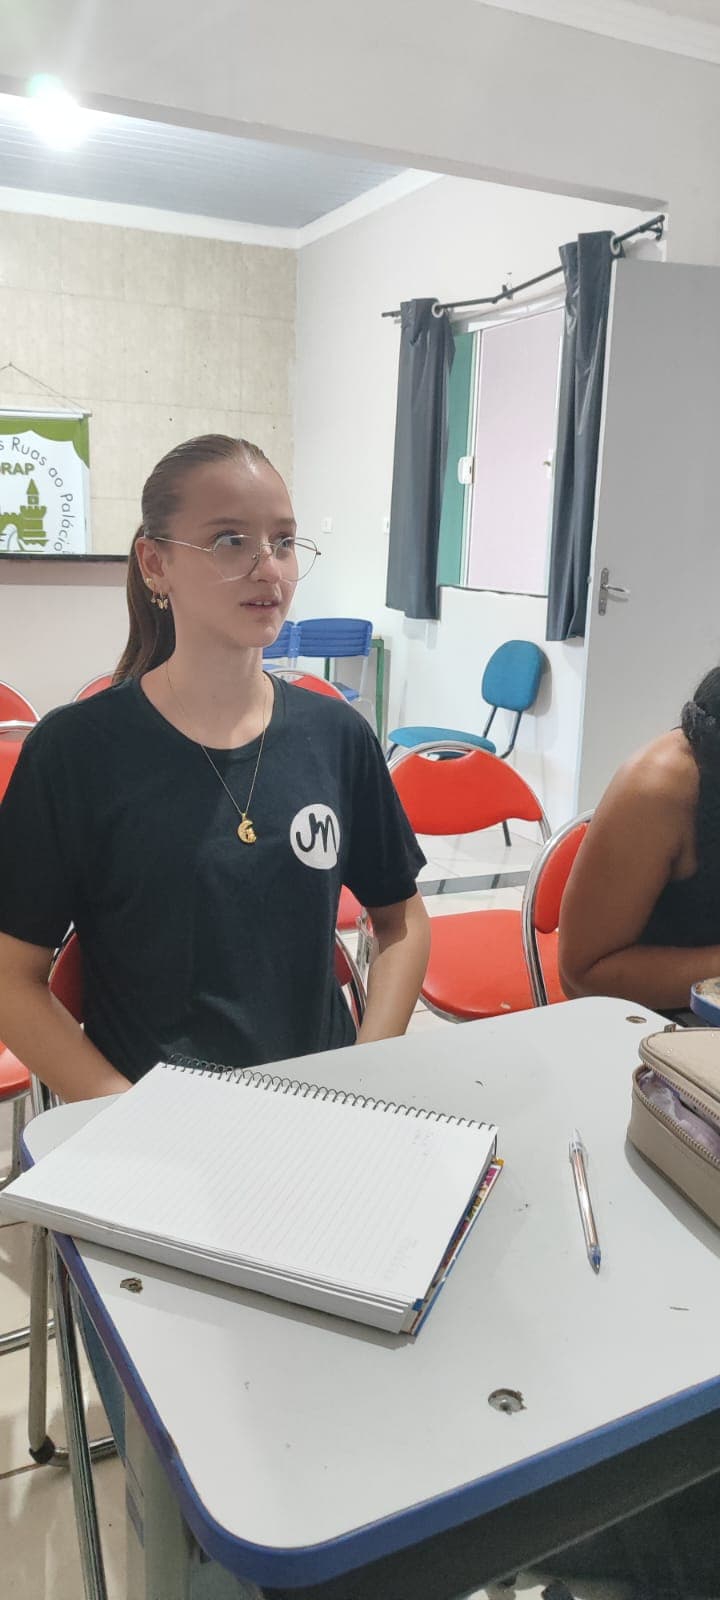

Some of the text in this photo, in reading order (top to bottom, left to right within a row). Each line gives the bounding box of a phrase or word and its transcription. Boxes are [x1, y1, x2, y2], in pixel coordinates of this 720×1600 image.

[11, 436, 48, 466] Ruas
[0, 462, 35, 475] RAP
[48, 467, 64, 488] ao
[53, 493, 76, 551] Palácio
